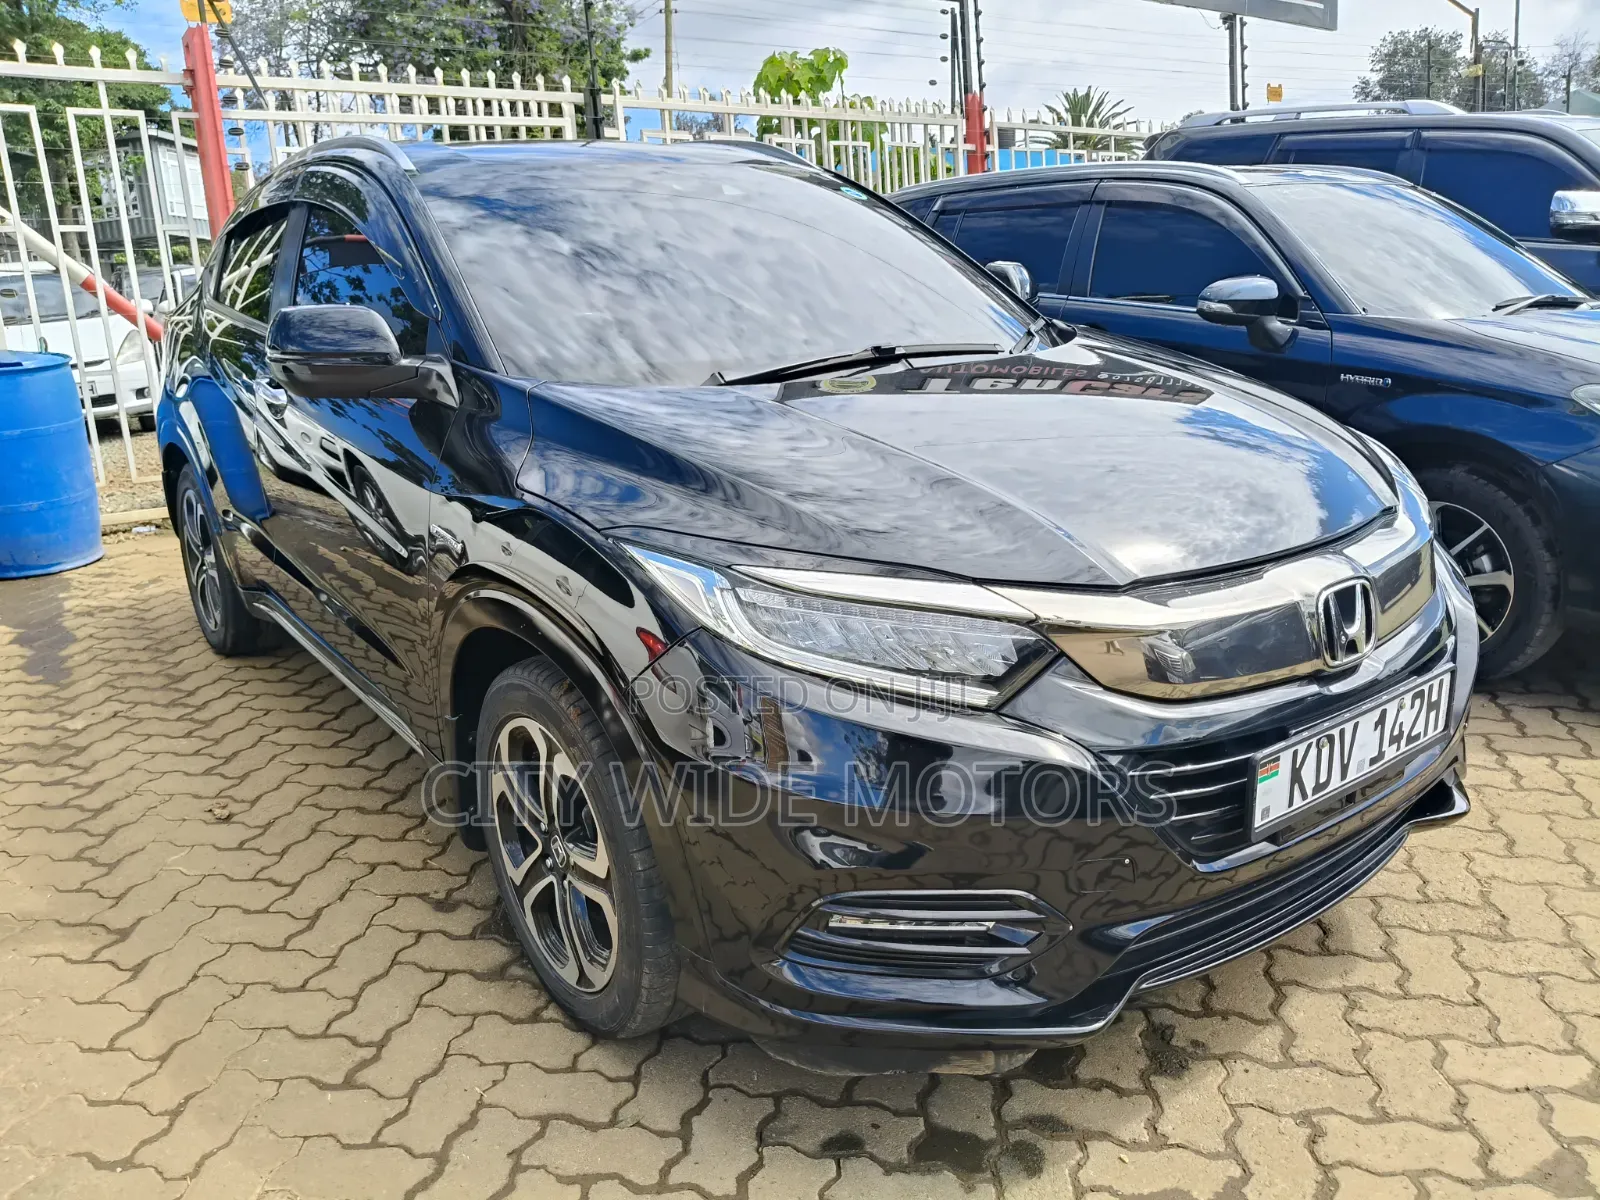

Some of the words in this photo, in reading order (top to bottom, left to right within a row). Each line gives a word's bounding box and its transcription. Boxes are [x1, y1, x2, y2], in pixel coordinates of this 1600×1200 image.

[1340, 373, 1384, 386] HYBRID
[1288, 720, 1360, 808] KDV
[1369, 679, 1444, 767] 142H
